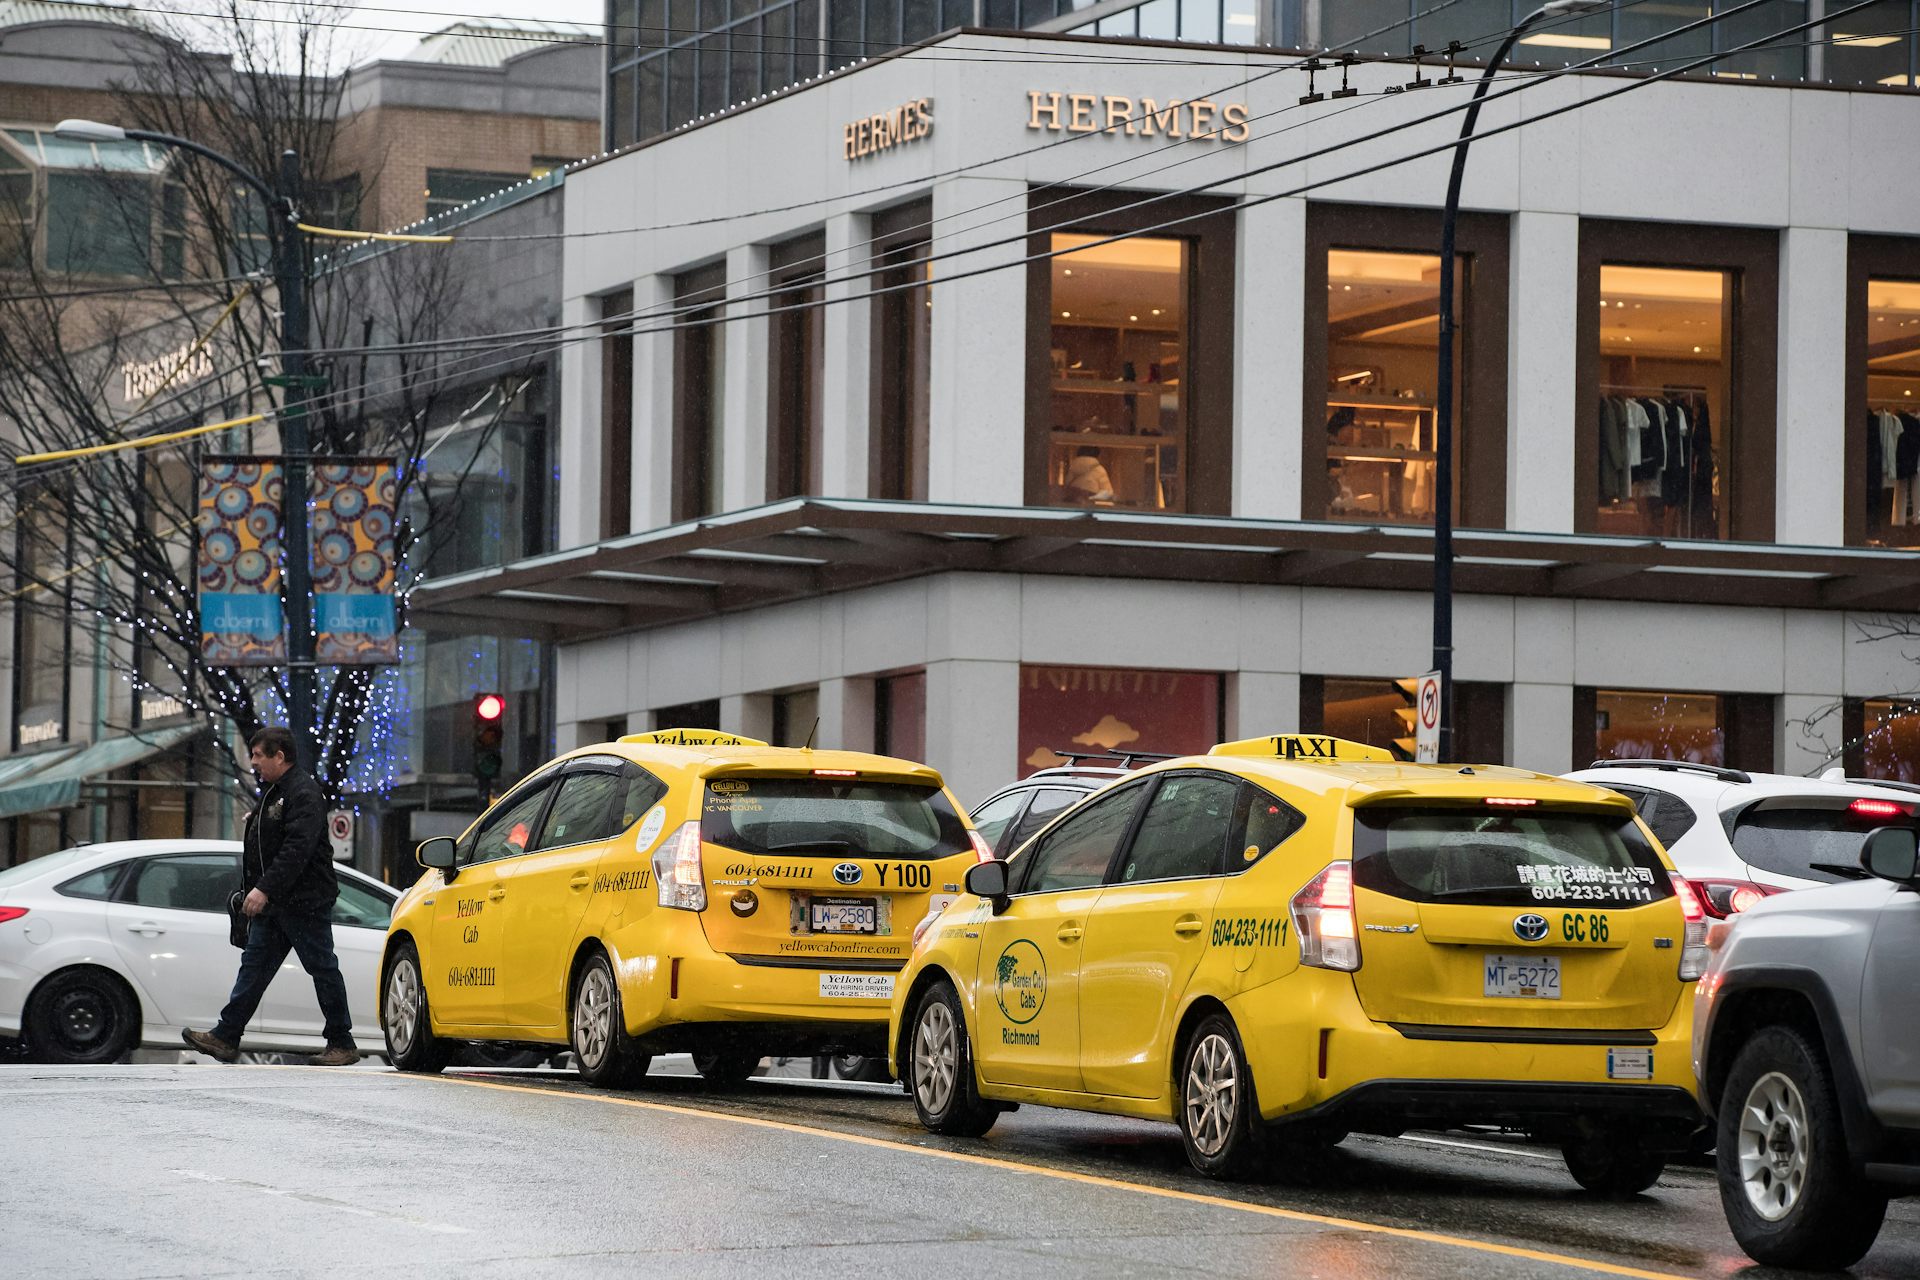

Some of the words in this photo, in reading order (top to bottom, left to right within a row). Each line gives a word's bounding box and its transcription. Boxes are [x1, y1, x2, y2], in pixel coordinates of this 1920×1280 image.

[1270, 736, 1339, 758] TAXI
[725, 863, 814, 879] 604-681-1111
[874, 863, 889, 887] Y
[893, 863, 932, 888] 100
[1516, 864, 1656, 885] 請電花城的士公司
[1531, 885, 1652, 901] 604-233-1111
[457, 898, 485, 919] Yellow
[463, 925, 479, 944] Cab
[1212, 918, 1289, 947] 604-233-1111
[1562, 913, 1586, 942] GC
[1590, 914, 1610, 943] 86
[779, 940, 900, 955] yellowcabonline.com
[828, 975, 865, 984] Yellow
[867, 976, 887, 985] Cab
[1012, 969, 1032, 989] Garden
[1032, 970, 1044, 993] City
[1518, 967, 1559, 988] 5272
[1020, 990, 1037, 1009] Cabs
[1002, 1027, 1040, 1046] Richmond
